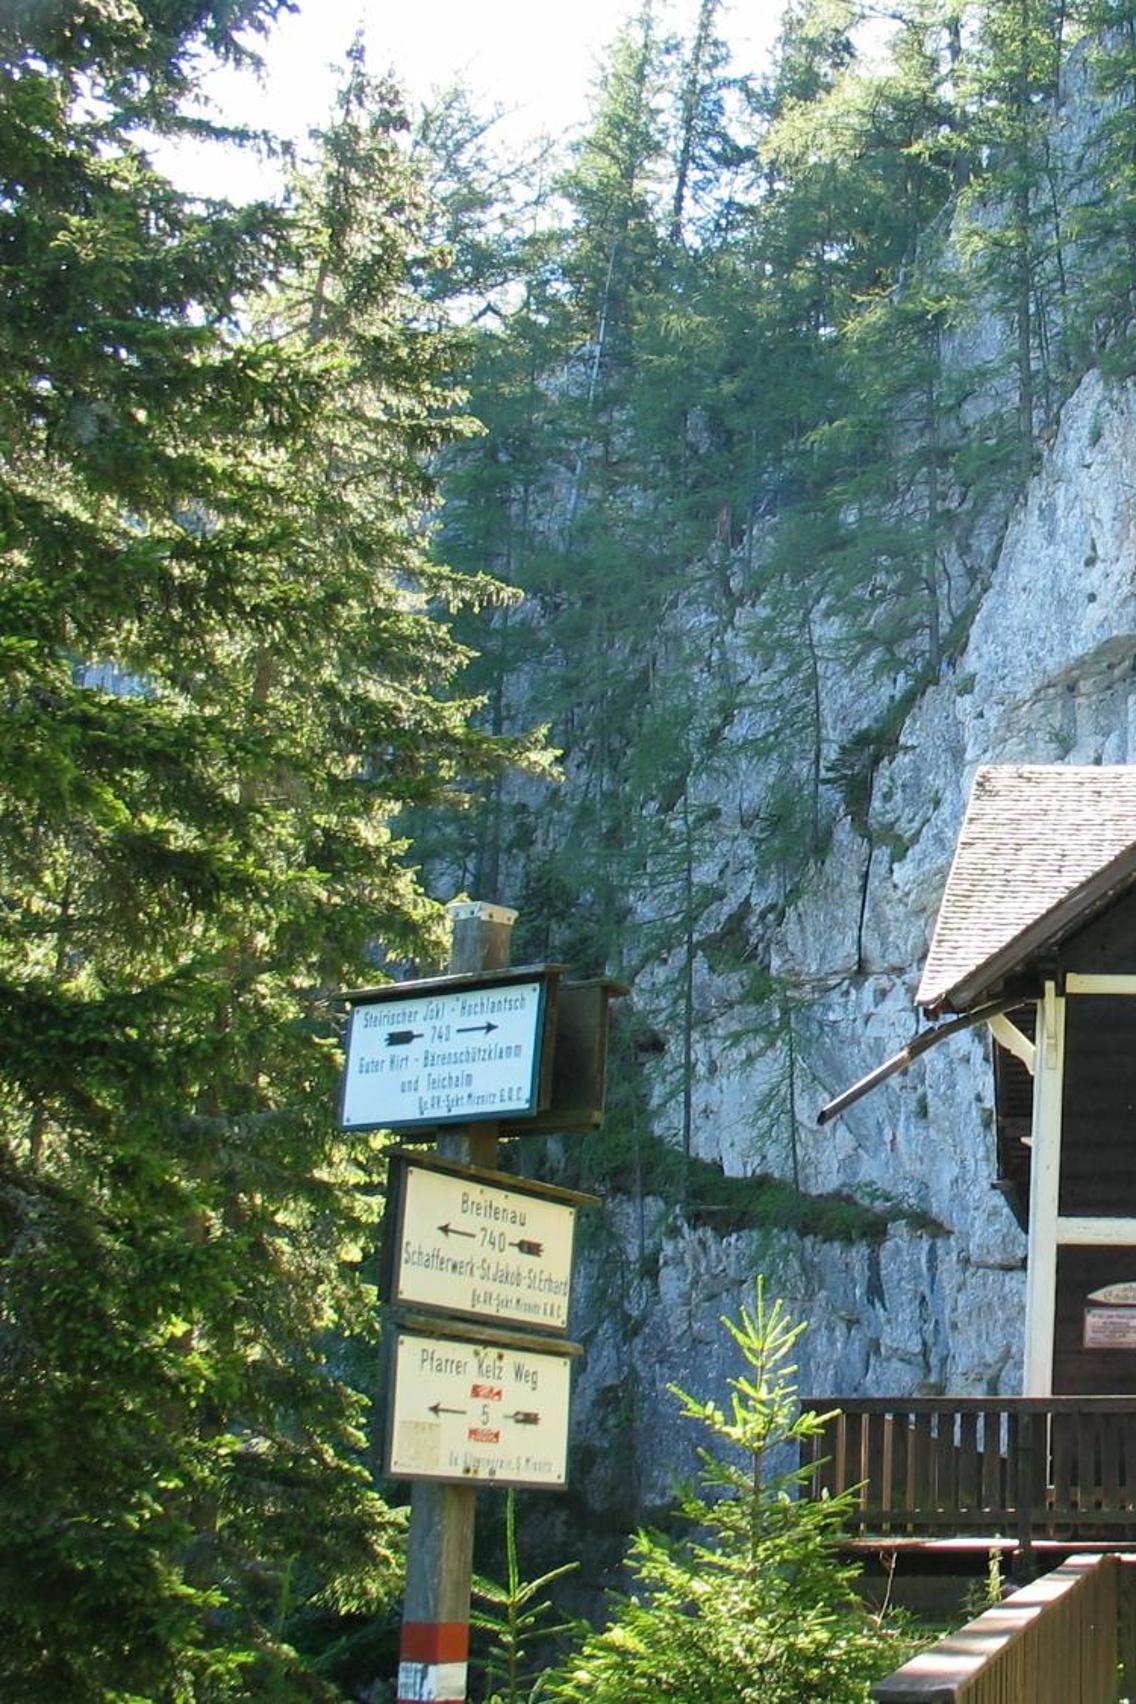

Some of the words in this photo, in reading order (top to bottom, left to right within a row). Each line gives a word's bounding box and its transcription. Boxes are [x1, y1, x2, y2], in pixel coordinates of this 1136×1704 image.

[460, 993, 527, 1017] Hochlantsch
[430, 1024, 452, 1044] 740
[461, 1191, 527, 1227] Breitenau
[480, 1226, 507, 1253] 740
[420, 1348, 469, 1376] Pfarrer
[513, 1360, 539, 1391] Weg
[481, 1403, 490, 1426] 5
